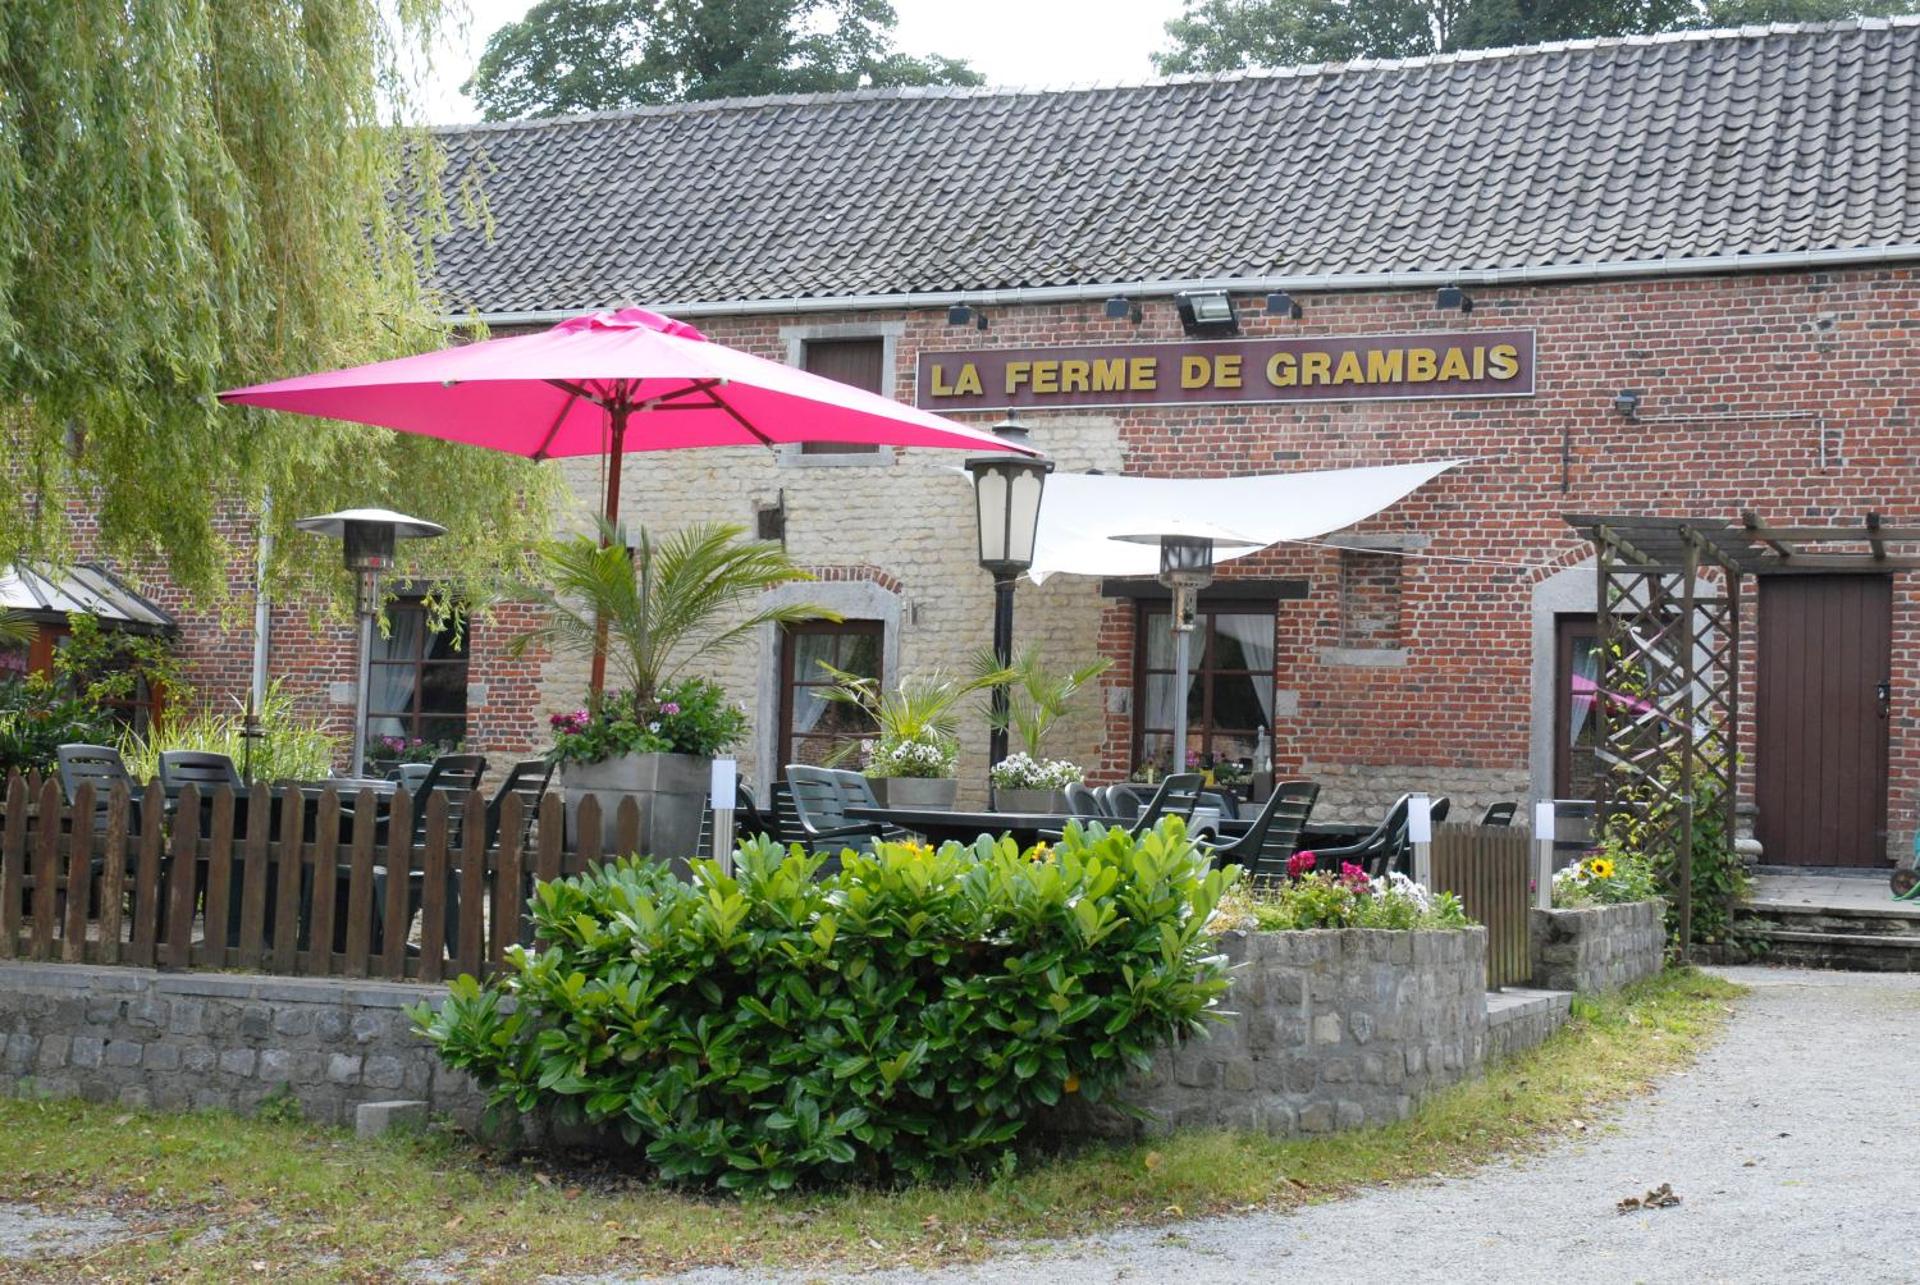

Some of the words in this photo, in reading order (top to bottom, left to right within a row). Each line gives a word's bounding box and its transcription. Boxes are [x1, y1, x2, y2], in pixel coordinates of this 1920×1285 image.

[931, 363, 983, 397] LA
[1005, 358, 1158, 394] FERME
[1181, 354, 1243, 389] DE
[1266, 344, 1520, 387] GRAMBAIS
